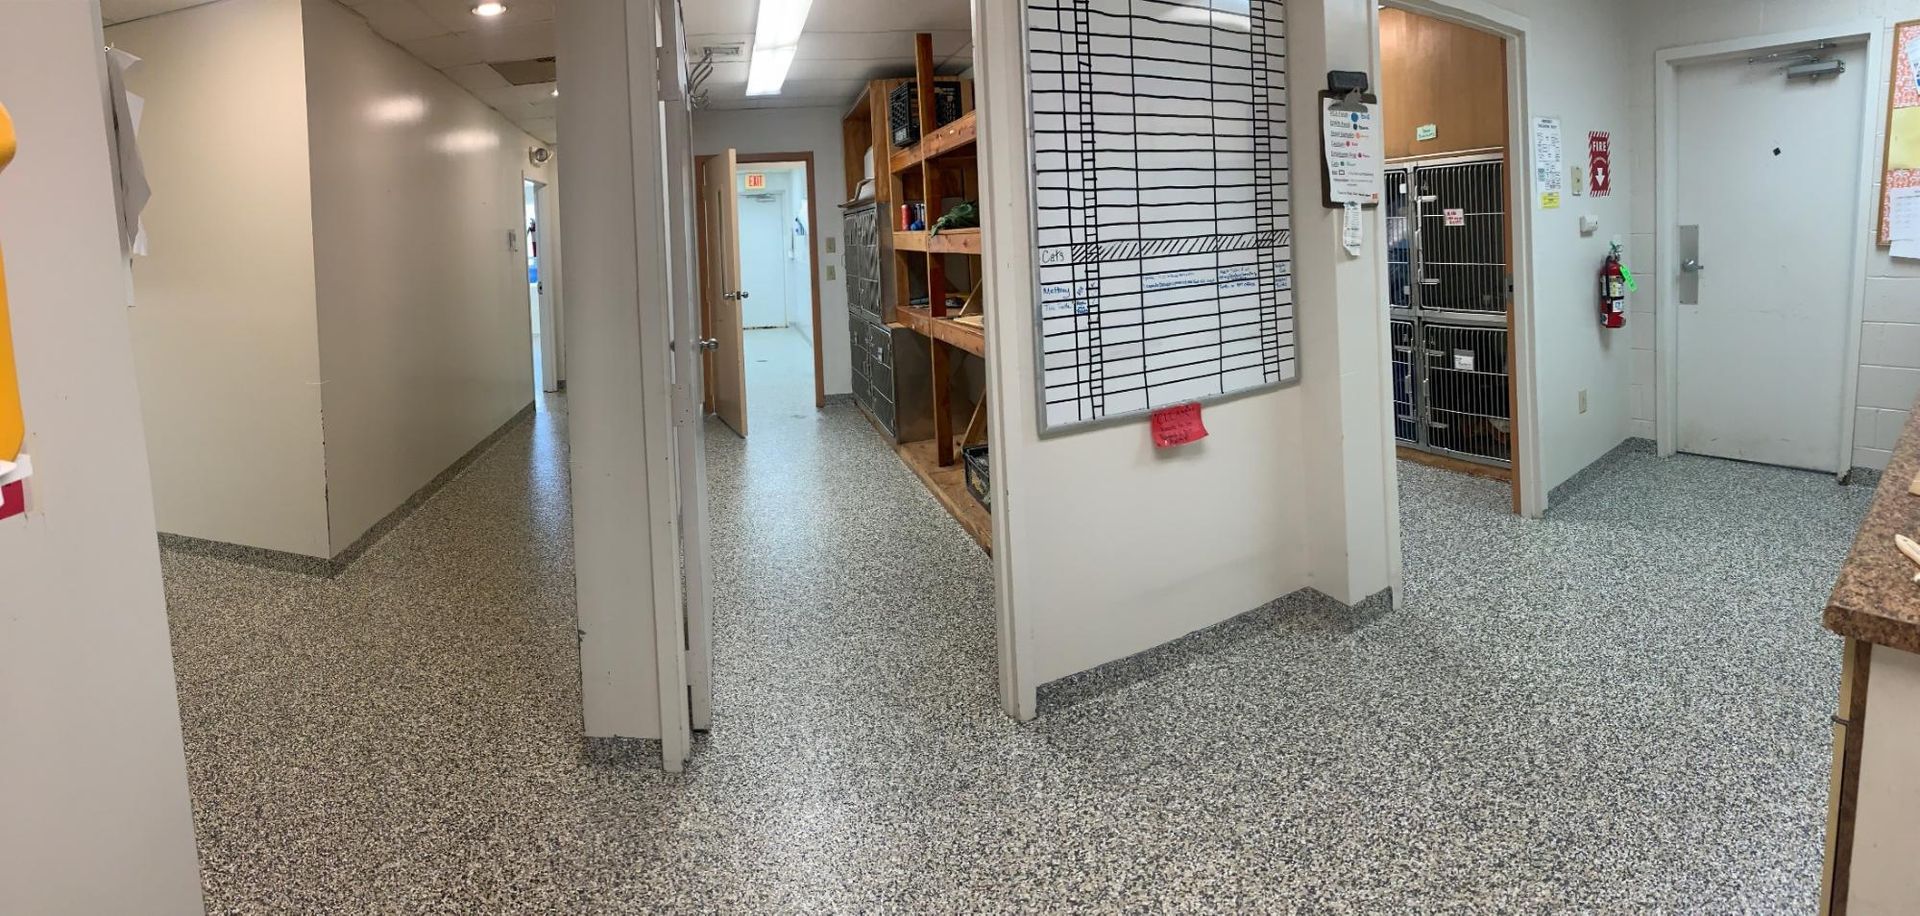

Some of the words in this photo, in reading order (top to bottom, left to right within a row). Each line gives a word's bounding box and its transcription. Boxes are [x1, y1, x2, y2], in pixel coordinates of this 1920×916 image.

[1592, 141, 1607, 151] FIRE
[748, 175, 762, 187] EXIT
[1042, 249, 1065, 264] Cats
